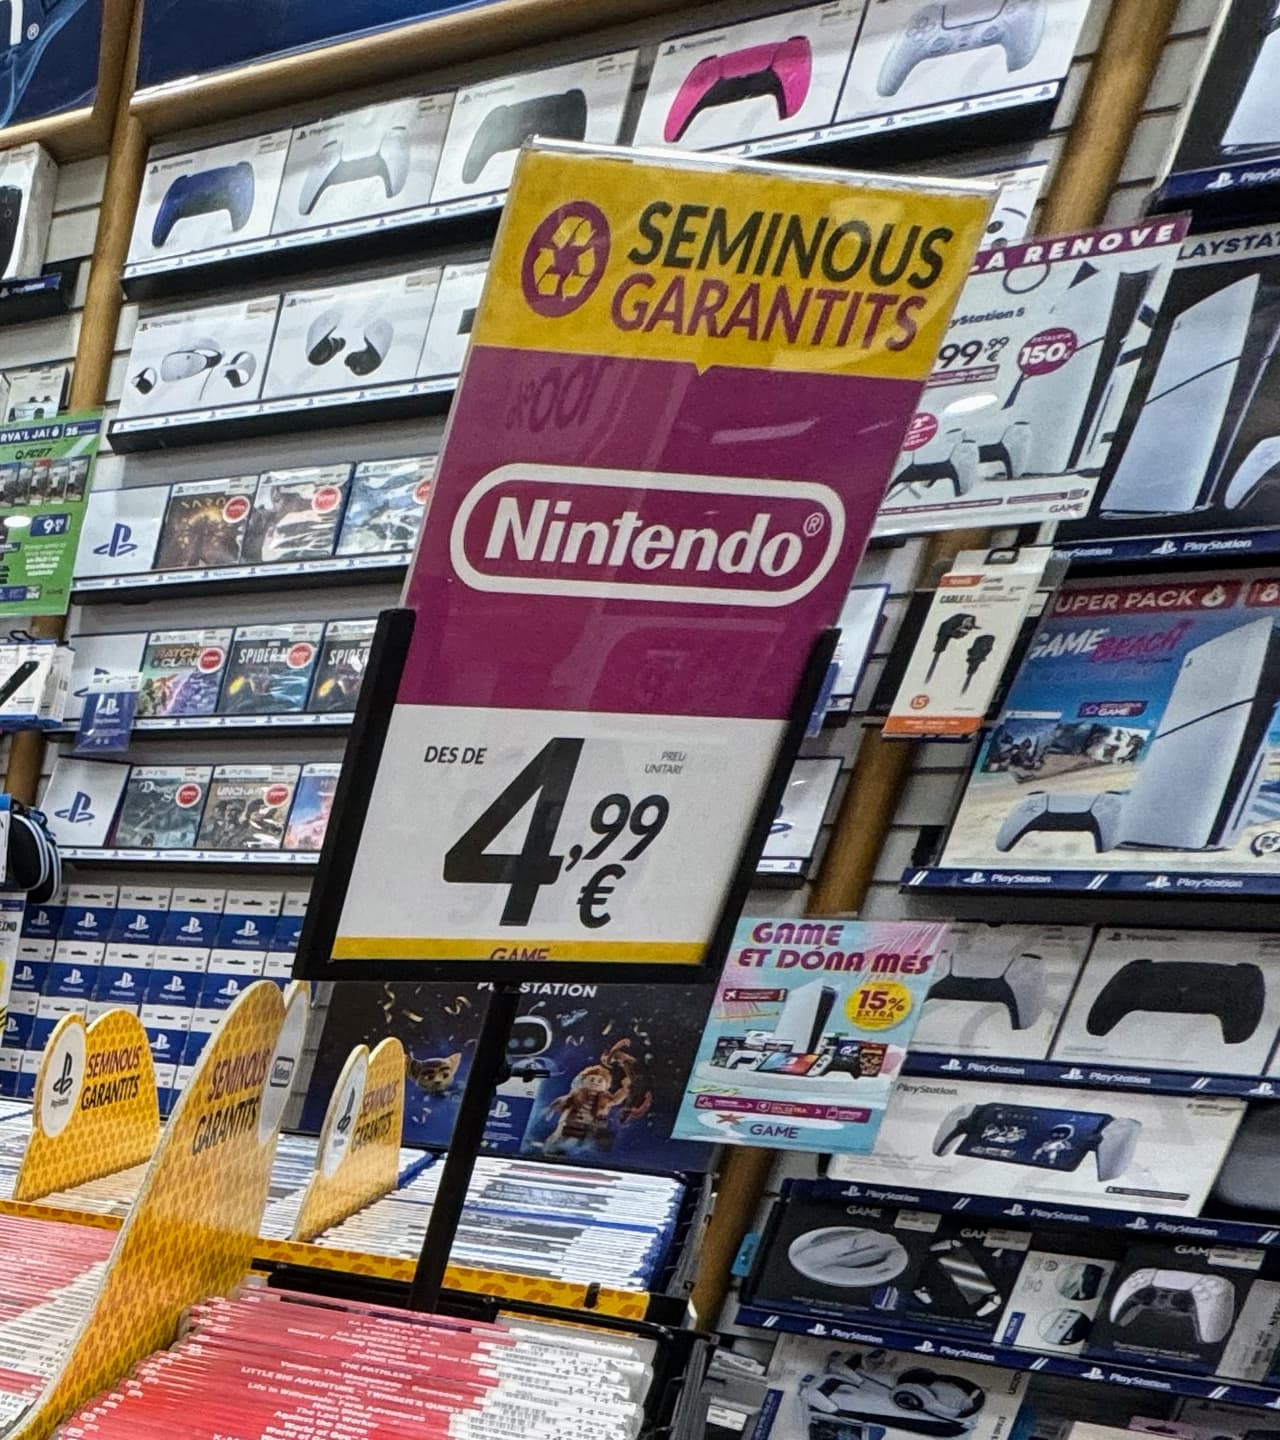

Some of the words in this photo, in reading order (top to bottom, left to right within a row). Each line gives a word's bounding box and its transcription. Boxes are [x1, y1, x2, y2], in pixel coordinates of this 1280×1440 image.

[628, 201, 954, 289] SEMINOUS
[1024, 222, 1177, 265] RENOVE
[610, 272, 927, 353] GARANTITS
[1048, 503, 1084, 514] GAME
[484, 497, 804, 579] Nintendo
[1184, 538, 1252, 552] PlayStation
[1055, 590, 1122, 613] UPER
[1125, 589, 1194, 609] PACK
[424, 747, 459, 764] DES
[461, 748, 487, 765] DE
[442, 736, 670, 927] 4,99
[576, 863, 627, 929] €
[991, 873, 1051, 885] PlayStation
[1176, 877, 1244, 889] PlayStation
[752, 922, 845, 947] GAME
[739, 948, 772, 968] ET
[776, 945, 866, 973] DÓNA
[870, 947, 935, 975] MÉS
[477, 981, 599, 999] PLSTATION
[87, 1045, 143, 1079] SEMINOUS
[967, 1062, 1025, 1076] PlayStation
[1090, 1071, 1151, 1085] PlayStation
[81, 1075, 141, 1112] GARANTITS
[896, 1082, 958, 1096] PlayStation
[749, 1123, 800, 1139] GAME
[846, 1205, 882, 1217] GAME
[1031, 1208, 1090, 1223] PlayStation
[832, 1329, 883, 1344] PlayStation
